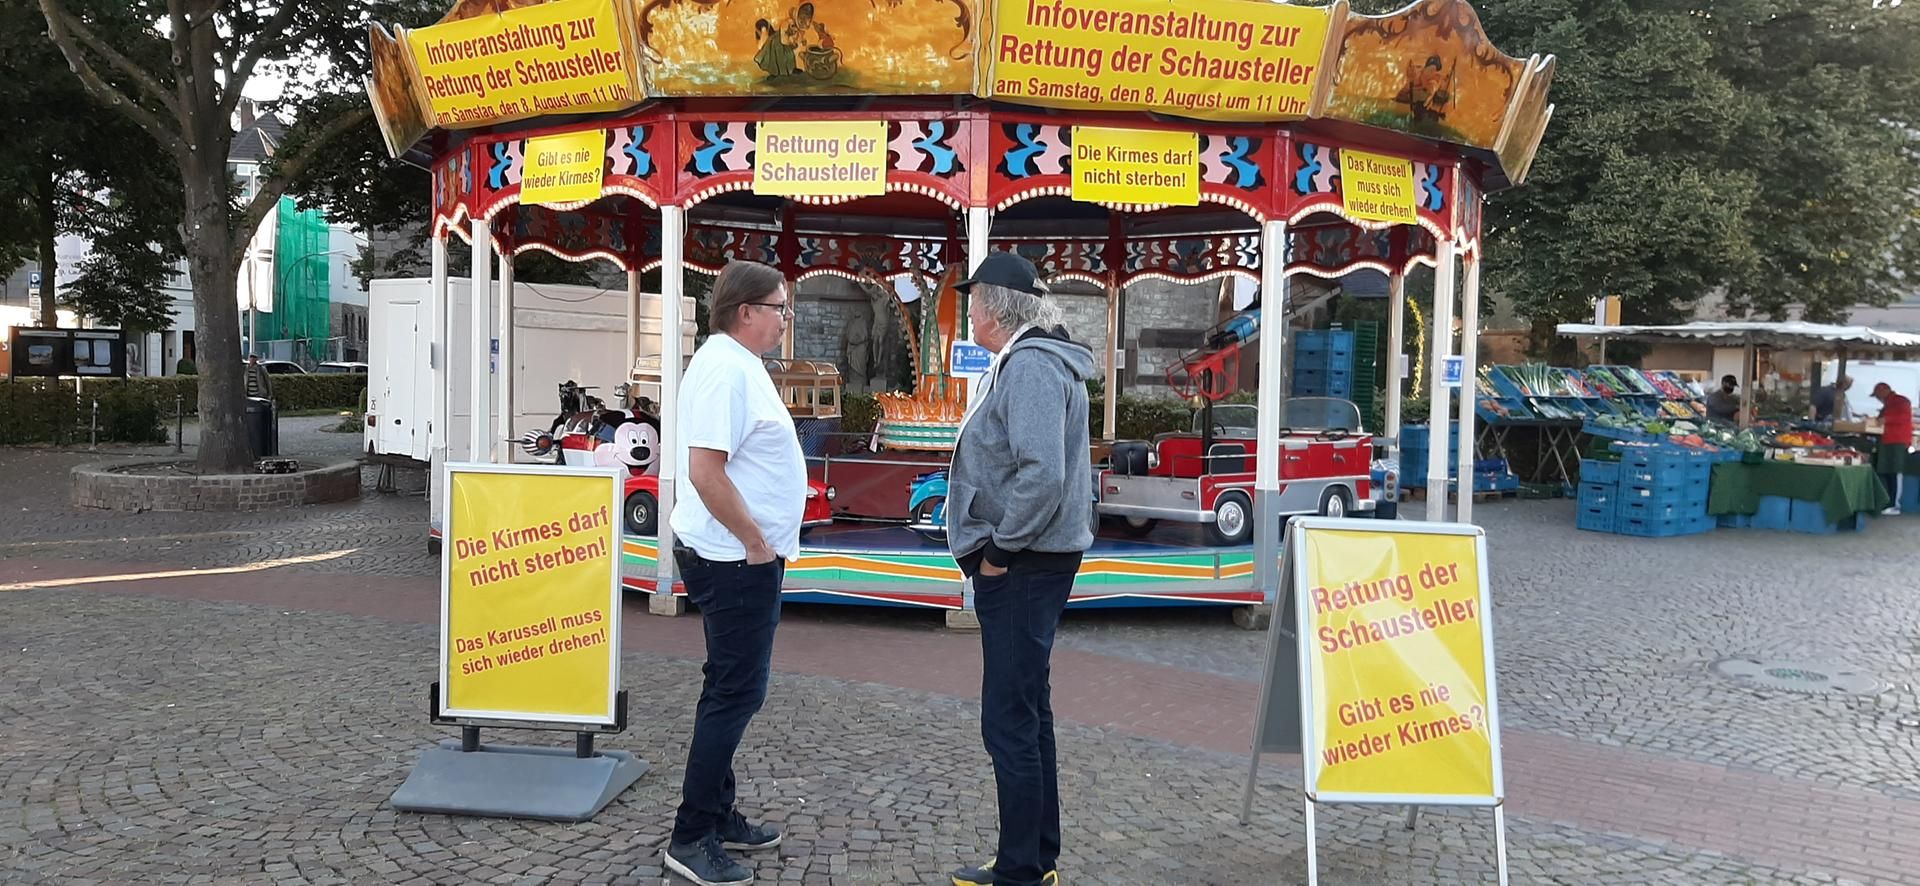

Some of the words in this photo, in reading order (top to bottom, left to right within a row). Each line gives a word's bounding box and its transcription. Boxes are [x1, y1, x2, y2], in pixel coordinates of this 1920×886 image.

[425, 20, 566, 65] Infoveranstaltung
[568, 16, 597, 41] zur
[1026, 0, 1254, 50] Infoveranstaltung
[1260, 23, 1300, 47] zur
[423, 65, 485, 101] Rettung
[486, 64, 513, 92] der
[514, 48, 623, 86] Schausteller
[999, 34, 1102, 77] Rettung
[1111, 45, 1152, 74] der
[1159, 47, 1314, 86] Schausteller
[437, 110, 451, 124] am
[500, 99, 520, 115] den
[520, 97, 532, 113] 8.
[533, 91, 573, 110] August
[575, 93, 592, 105] um
[593, 86, 608, 103] 11
[996, 78, 1022, 95] am
[1028, 77, 1104, 104] Samstag,
[1110, 85, 1139, 103] den
[1144, 87, 1158, 104] 8.
[1163, 87, 1223, 110] August
[1225, 96, 1250, 110] um
[1256, 95, 1273, 112] 11
[1278, 96, 1306, 114] Uhr
[537, 149, 559, 167] Gibt
[560, 152, 572, 165] es
[574, 148, 590, 163] nie
[766, 135, 839, 158] Rettung
[846, 134, 877, 153] der
[1077, 145, 1101, 160] Die
[1107, 146, 1158, 163] Kirmes
[1163, 149, 1192, 165] darf
[1347, 155, 1365, 172] Das
[1366, 158, 1407, 178] Karussell
[524, 170, 556, 189] wieder
[558, 167, 601, 186] Kirmes?
[761, 162, 879, 181] Schausteller
[1084, 168, 1120, 184] nicht
[1126, 171, 1186, 187] sterben!
[1357, 180, 1383, 196] muss
[1383, 182, 1401, 197] sich
[1349, 197, 1377, 214] wieder
[1380, 201, 1412, 218] drehen!
[455, 537, 488, 560] Die
[492, 521, 563, 551] Kirmes
[568, 505, 609, 533] darf
[469, 558, 520, 587] nicht
[524, 536, 607, 574] sterben!
[1311, 574, 1414, 614] Rettung
[1418, 562, 1458, 590] der
[455, 636, 484, 654] Das
[487, 616, 557, 647] Karussell
[560, 609, 602, 631] muss
[1318, 598, 1476, 653] Schausteller
[461, 653, 493, 675] sich
[496, 643, 545, 668] wieder
[549, 627, 606, 656] drehen!
[1338, 697, 1384, 727] Gibt
[1389, 692, 1415, 714] es
[1419, 683, 1450, 707] nie
[1322, 732, 1391, 767] wieder
[1397, 704, 1484, 747] Kirmes?
